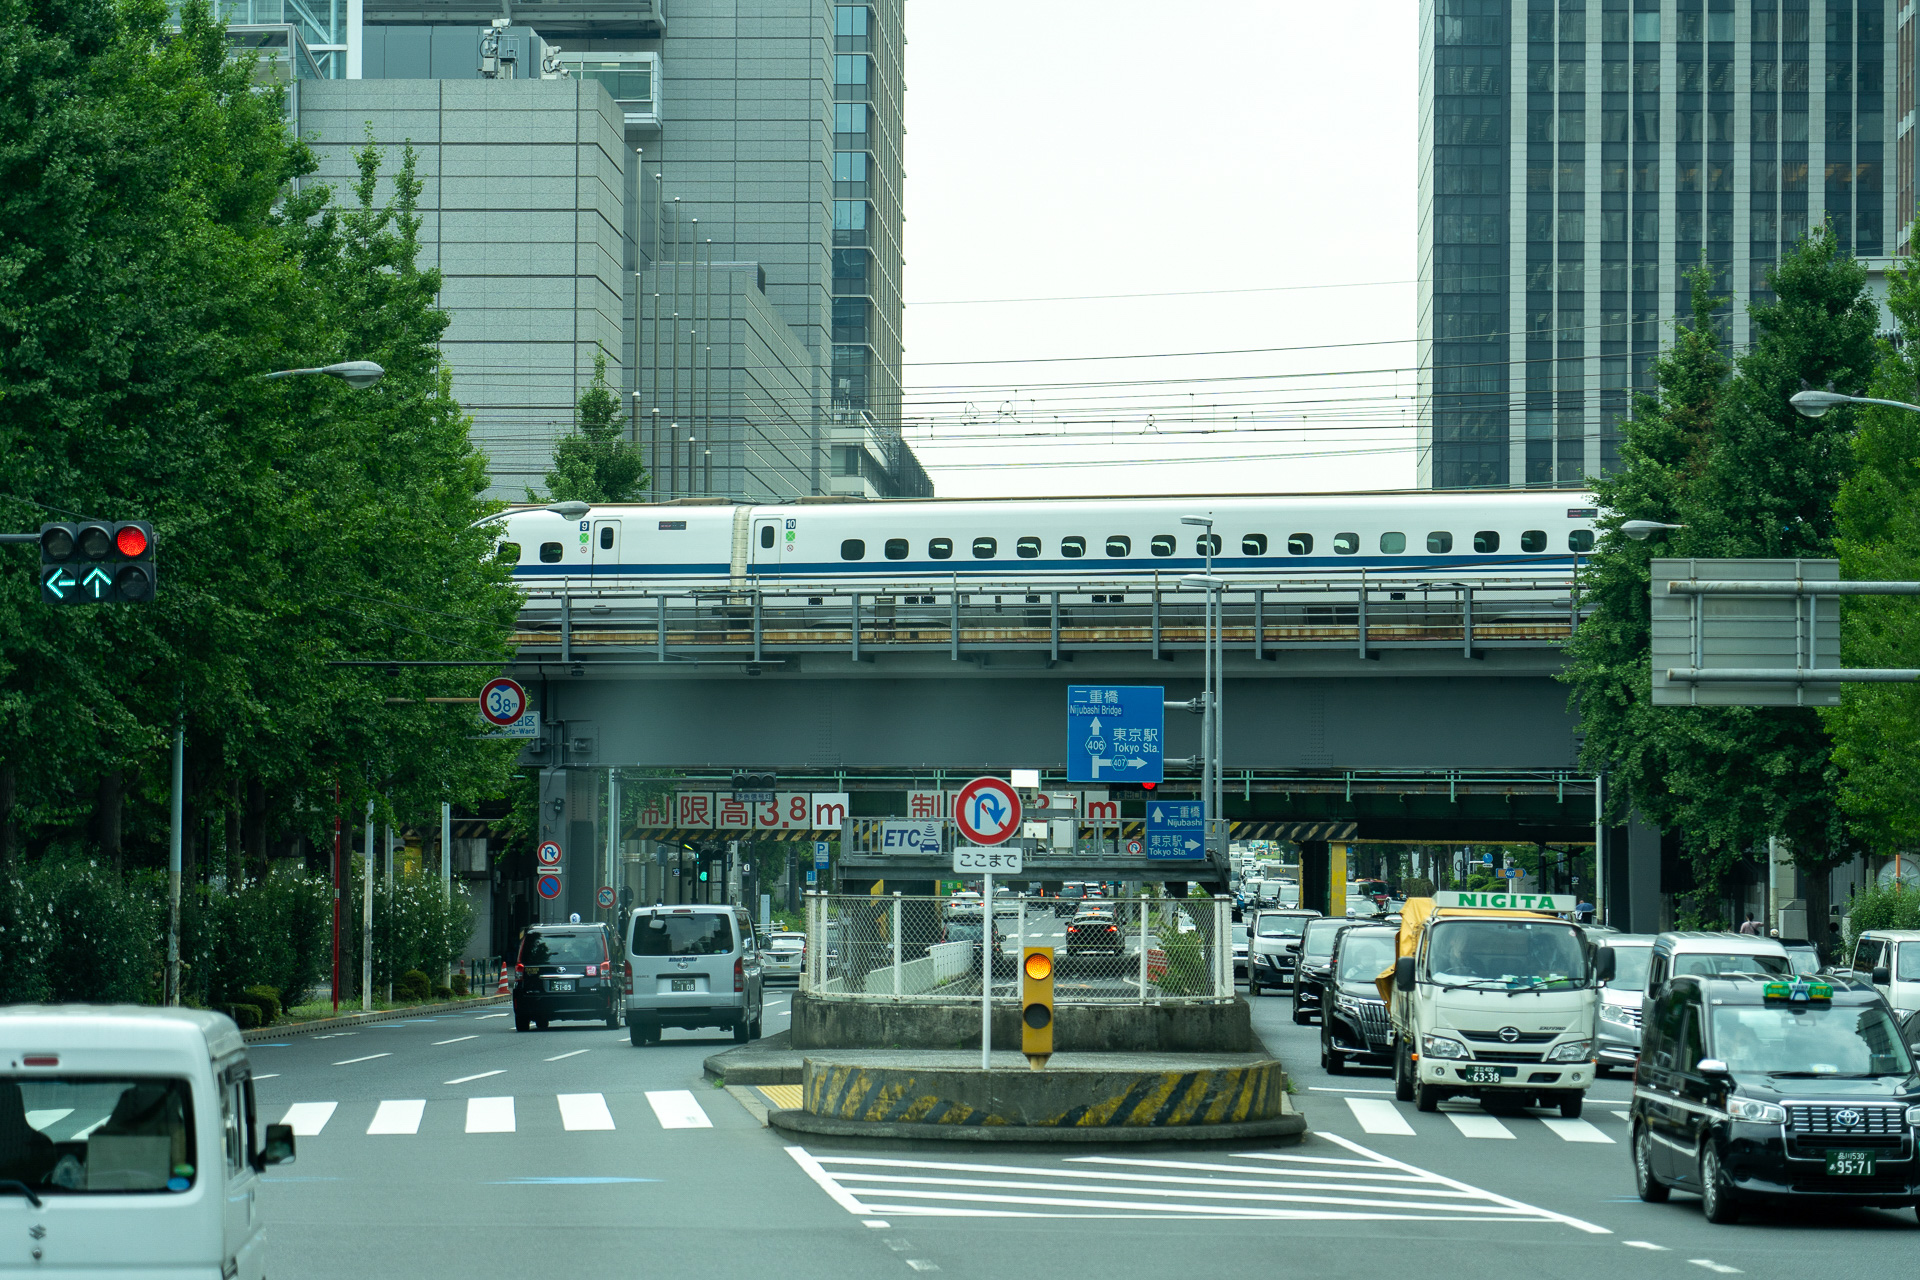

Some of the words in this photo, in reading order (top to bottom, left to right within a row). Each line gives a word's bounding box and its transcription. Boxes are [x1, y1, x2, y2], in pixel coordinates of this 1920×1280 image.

[582, 521, 588, 531] 9
[787, 520, 796, 529] 10
[1074, 690, 1119, 704] 二重橋
[1070, 705, 1100, 716] Nijubashi
[1101, 705, 1122, 716] Bridge
[1113, 728, 1158, 742] 東京駅
[1087, 740, 1104, 750] 406
[1113, 743, 1139, 754] Tokyo
[1143, 743, 1160, 753] Sta.
[1113, 758, 1125, 767] 407
[1170, 806, 1200, 818] 二重橋
[1167, 819, 1203, 828] Nijubashi
[884, 829, 921, 847] ETC
[1151, 835, 1183, 847] 東京駅
[817, 844, 826, 854] P
[1149, 847, 1171, 857] Tokyo
[1173, 847, 1187, 856] Sta.
[960, 853, 1018, 868] ここまで
[1458, 893, 1556, 910] NIGITA
